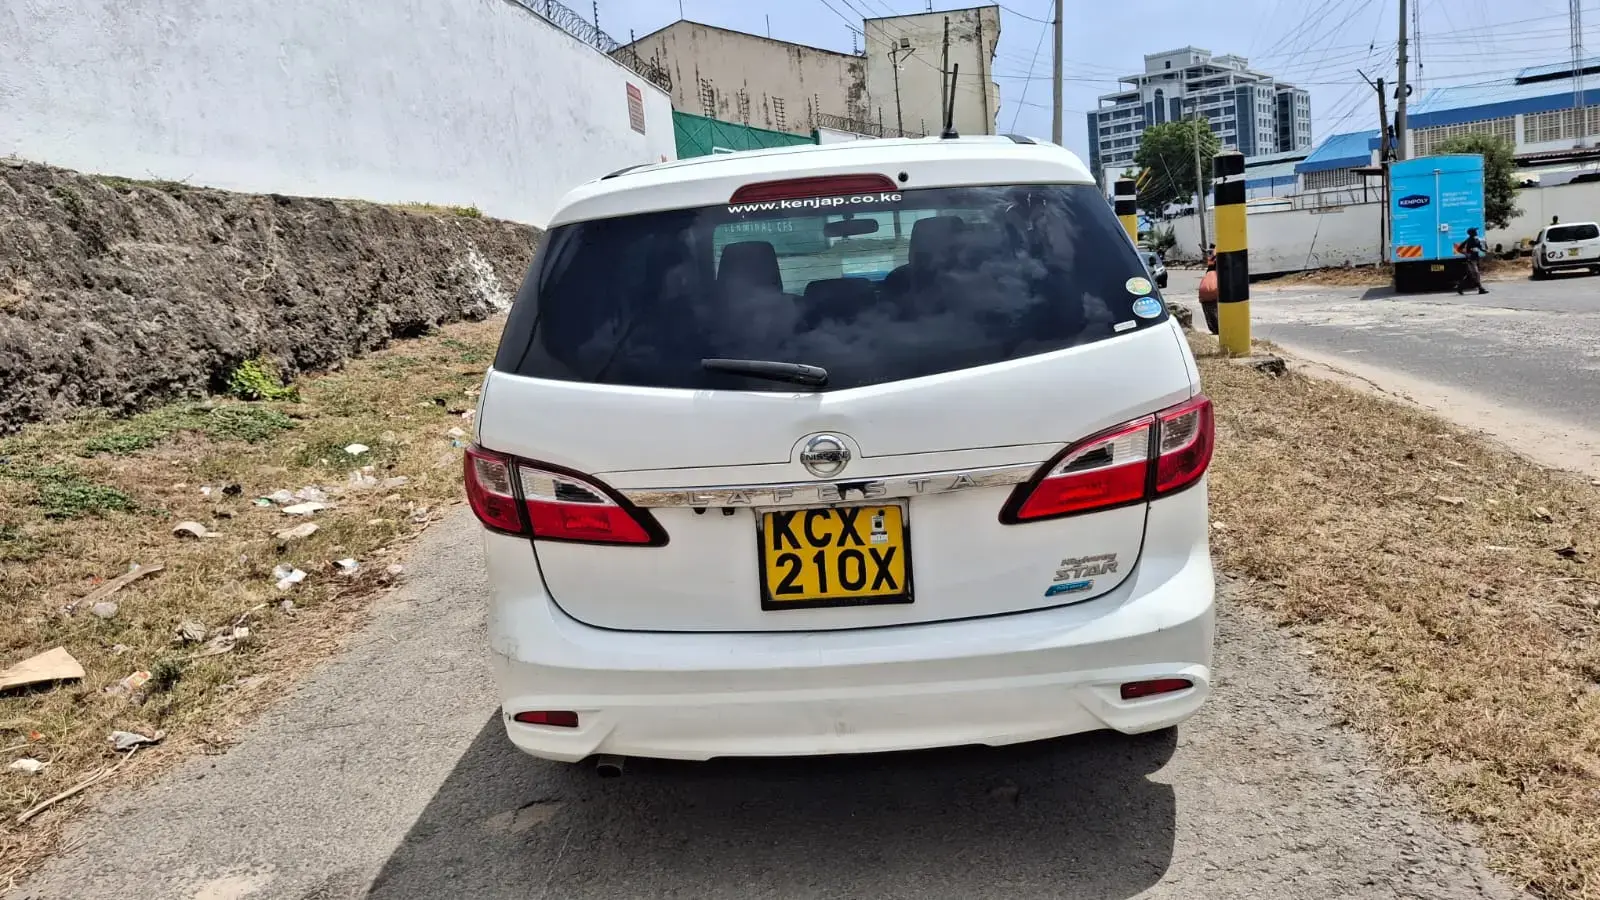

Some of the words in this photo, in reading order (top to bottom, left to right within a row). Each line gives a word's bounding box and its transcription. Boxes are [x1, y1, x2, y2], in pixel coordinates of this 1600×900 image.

[727, 193, 902, 214] www.kenjap.co.ke
[1400, 198, 1428, 206] KENPOLY
[805, 451, 846, 462] NISSAN
[686, 473, 979, 506] LAFESTA
[772, 507, 866, 551] KCX
[775, 546, 899, 595] 210X
[1060, 553, 1118, 567] Highway
[1052, 560, 1119, 582] STAR
